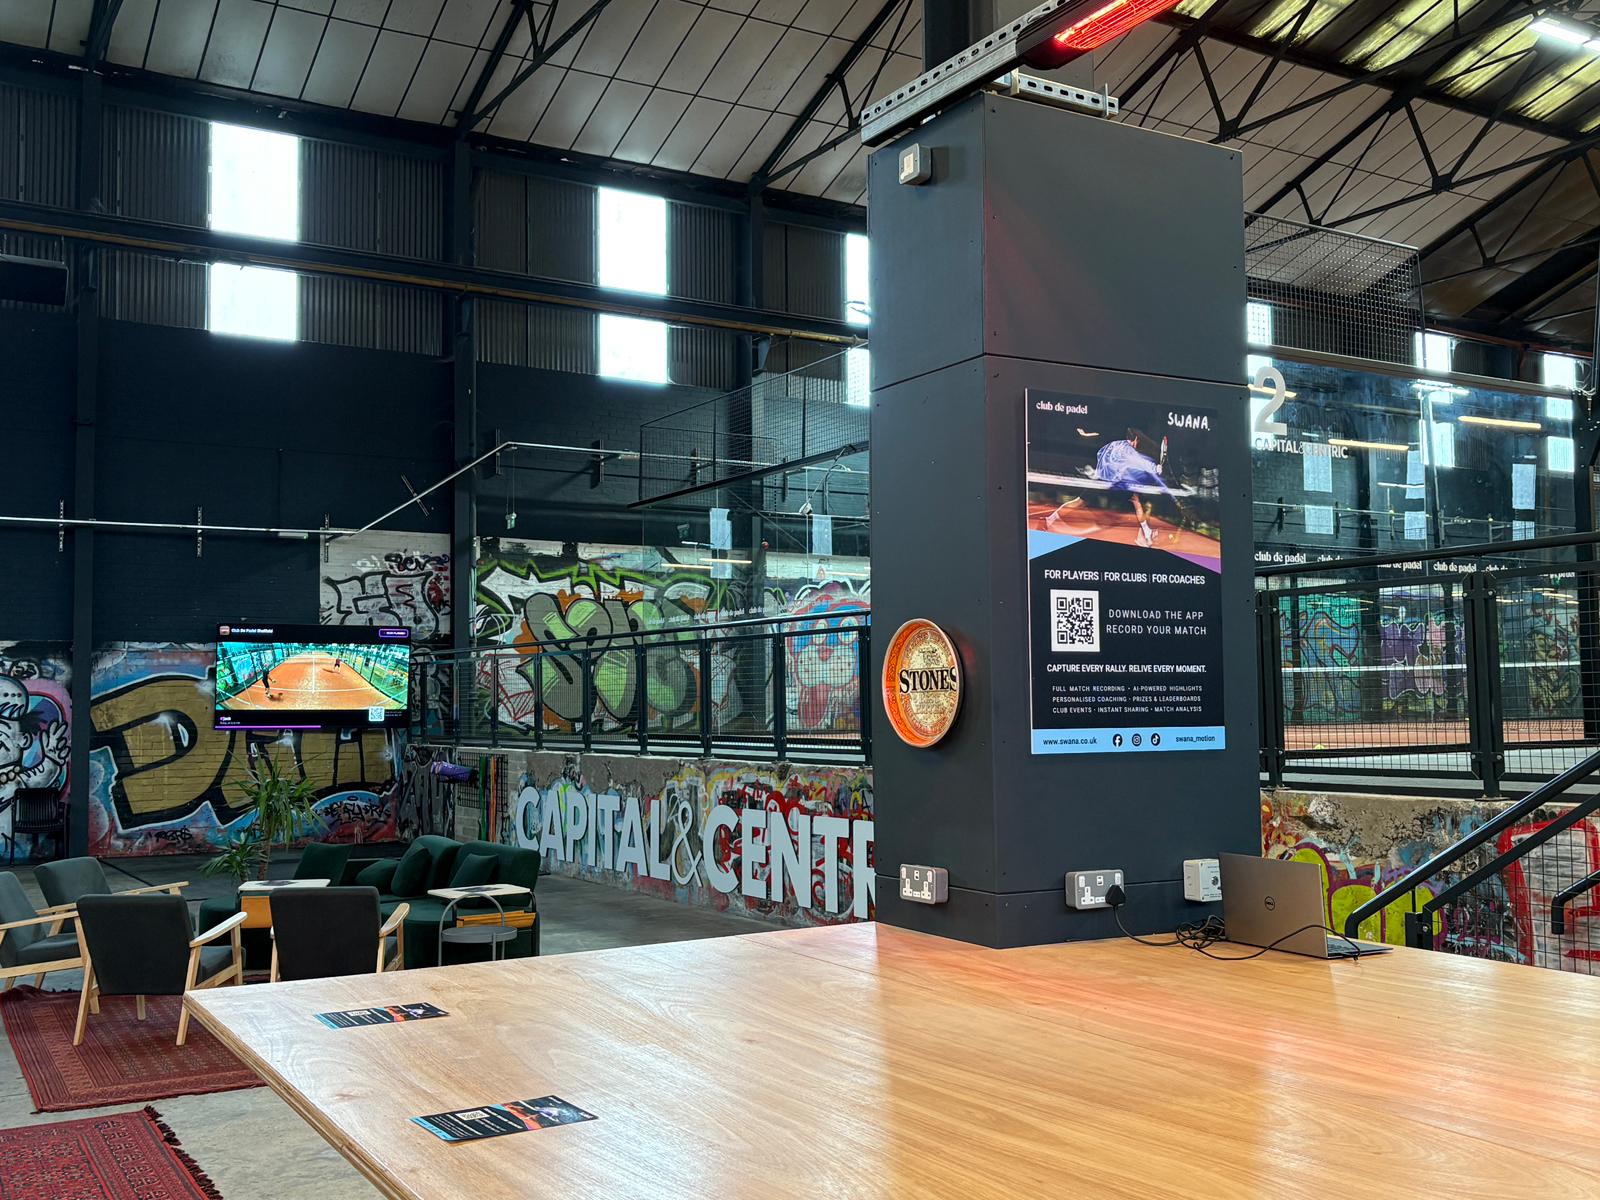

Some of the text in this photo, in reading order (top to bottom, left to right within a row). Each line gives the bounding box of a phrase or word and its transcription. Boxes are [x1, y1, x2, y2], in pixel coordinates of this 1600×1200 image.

[1254, 366, 1287, 436] 2
[1036, 401, 1088, 415] club de padel
[1254, 551, 1306, 565] club de padel
[1403, 561, 1422, 571] padel
[1433, 562, 1477, 573] club de padel
[1045, 570, 1099, 580] FOR PLAYERS
[1104, 572, 1147, 582] FOR CLUBS
[1152, 574, 1205, 584] FOR COACHES
[1109, 609, 1203, 620] DOWNLOAD THE APP
[1106, 625, 1206, 635] RECORD YOUR MATCH
[1047, 664, 1080, 672] CAPTURE
[1082, 664, 1103, 672] EVERY
[1176, 665, 1207, 673] MOMENT.
[899, 667, 957, 694] STONES
[1043, 737, 1097, 745] www.swana.co.uk
[1175, 734, 1216, 743] swana_motion
